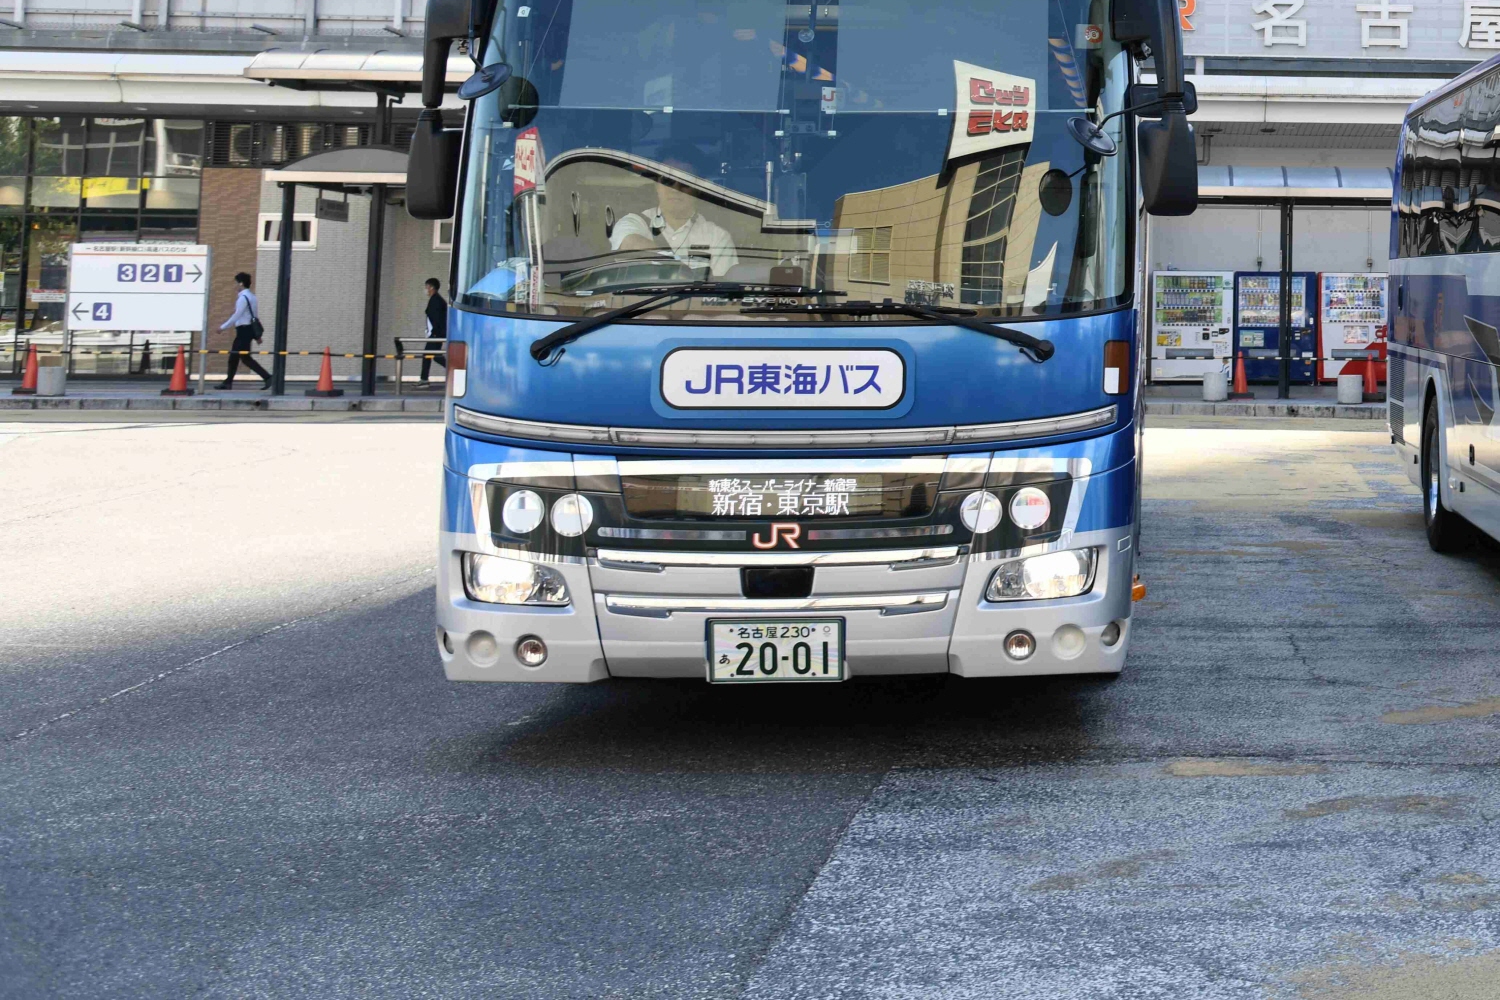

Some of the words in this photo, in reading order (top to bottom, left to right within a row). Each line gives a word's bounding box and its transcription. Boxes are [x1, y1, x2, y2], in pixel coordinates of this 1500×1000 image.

[120, 265, 134, 281] 3
[143, 265, 157, 281] 2
[168, 266, 178, 281] 1
[95, 304, 109, 319] 4
[685, 363, 882, 395] JR東海バス
[708, 478, 858, 493] 新東名スーパーライナー新宿号
[711, 492, 850, 516] 新宿・東京駅
[753, 522, 801, 549] JR
[718, 654, 731, 665] あ
[735, 641, 829, 676] 20-01
